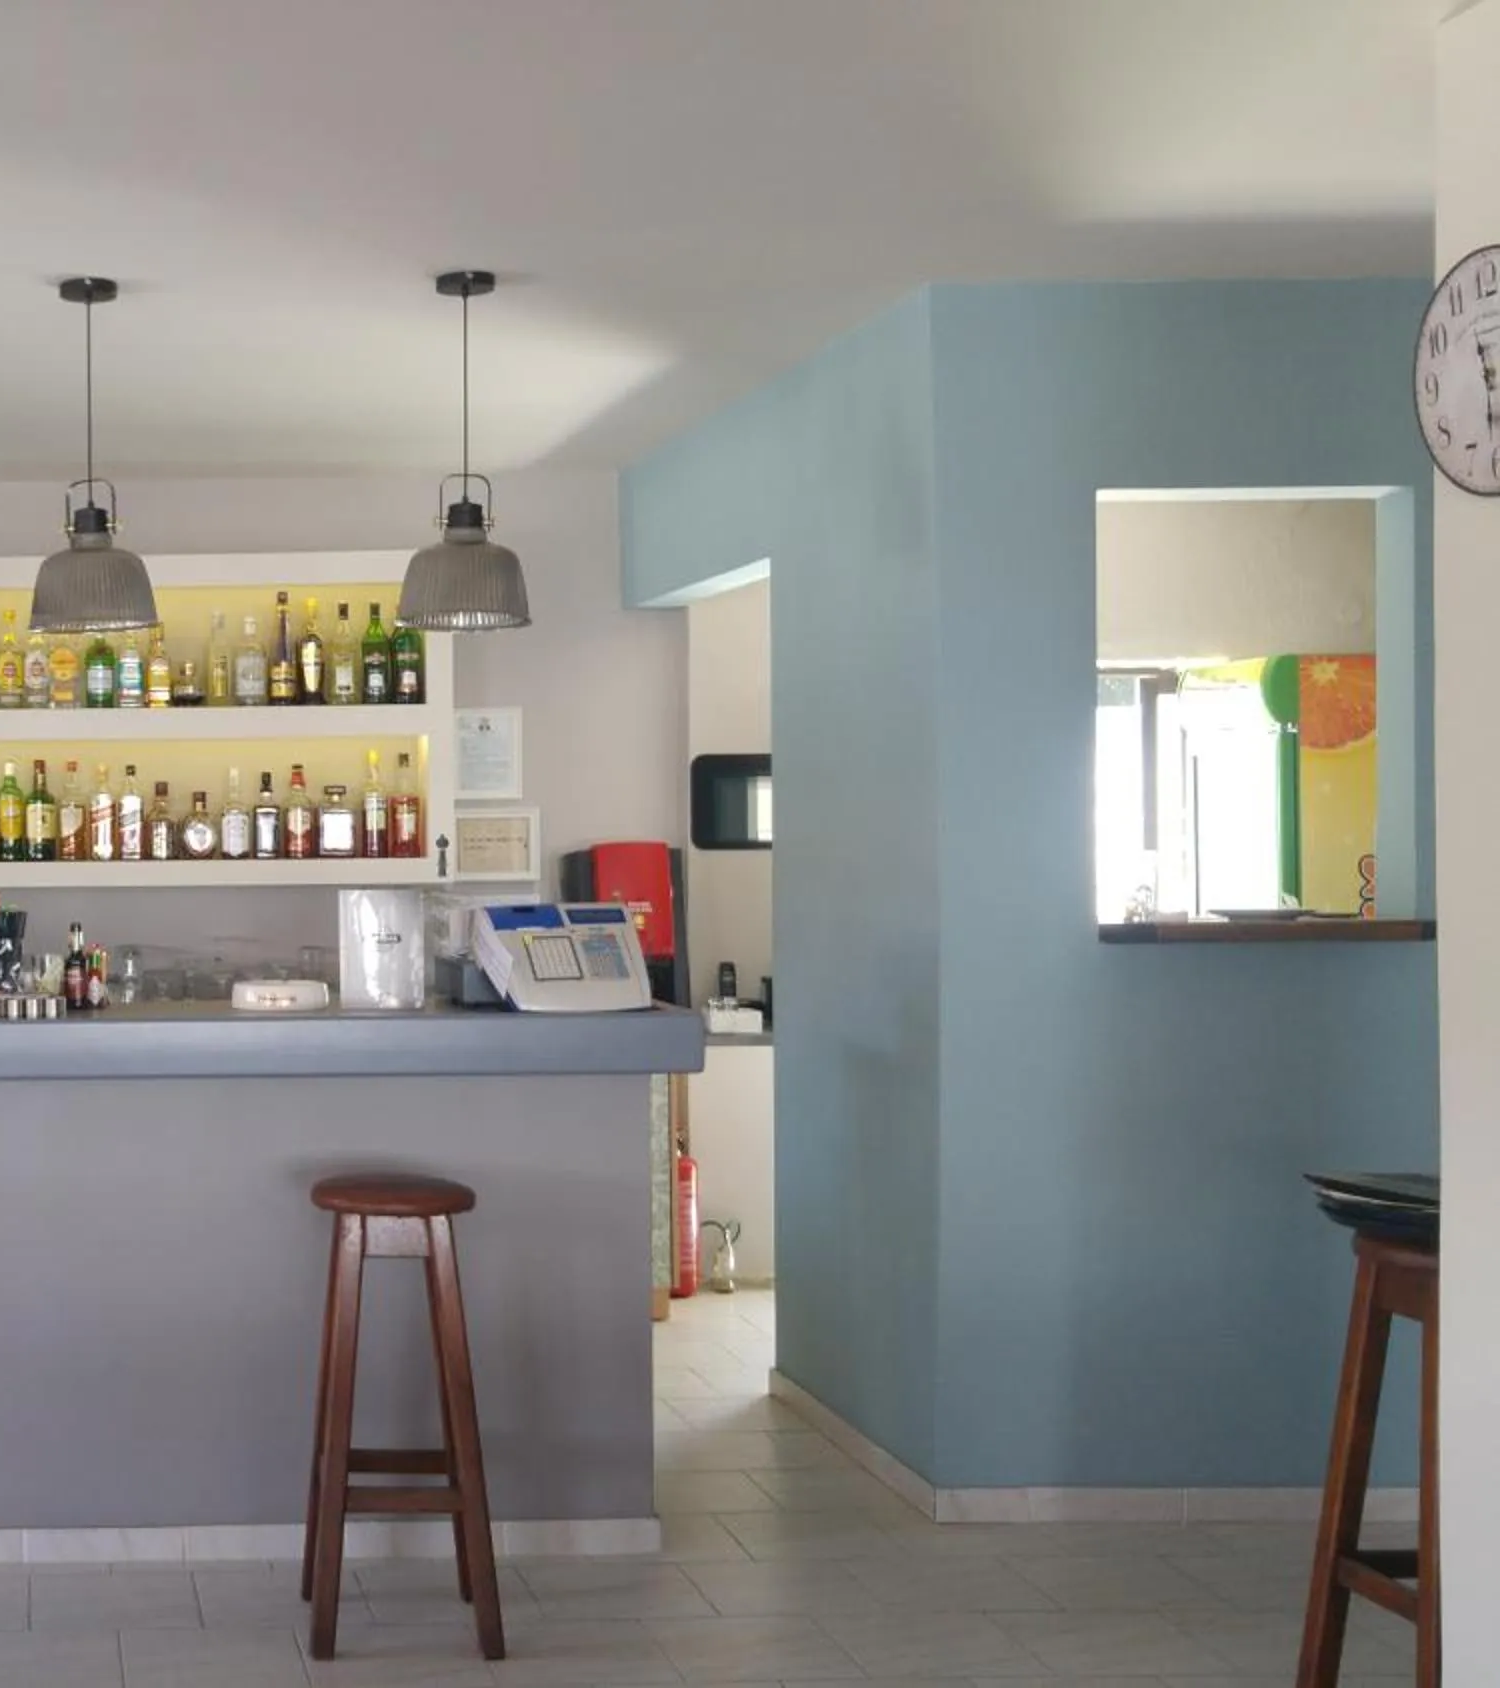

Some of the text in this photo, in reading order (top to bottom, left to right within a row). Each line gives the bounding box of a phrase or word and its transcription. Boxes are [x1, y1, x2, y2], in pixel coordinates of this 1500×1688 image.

[1475, 259, 1498, 300] 12
[1449, 282, 1463, 317] 11
[1429, 321, 1448, 359] 10
[1424, 371, 1439, 406] 9
